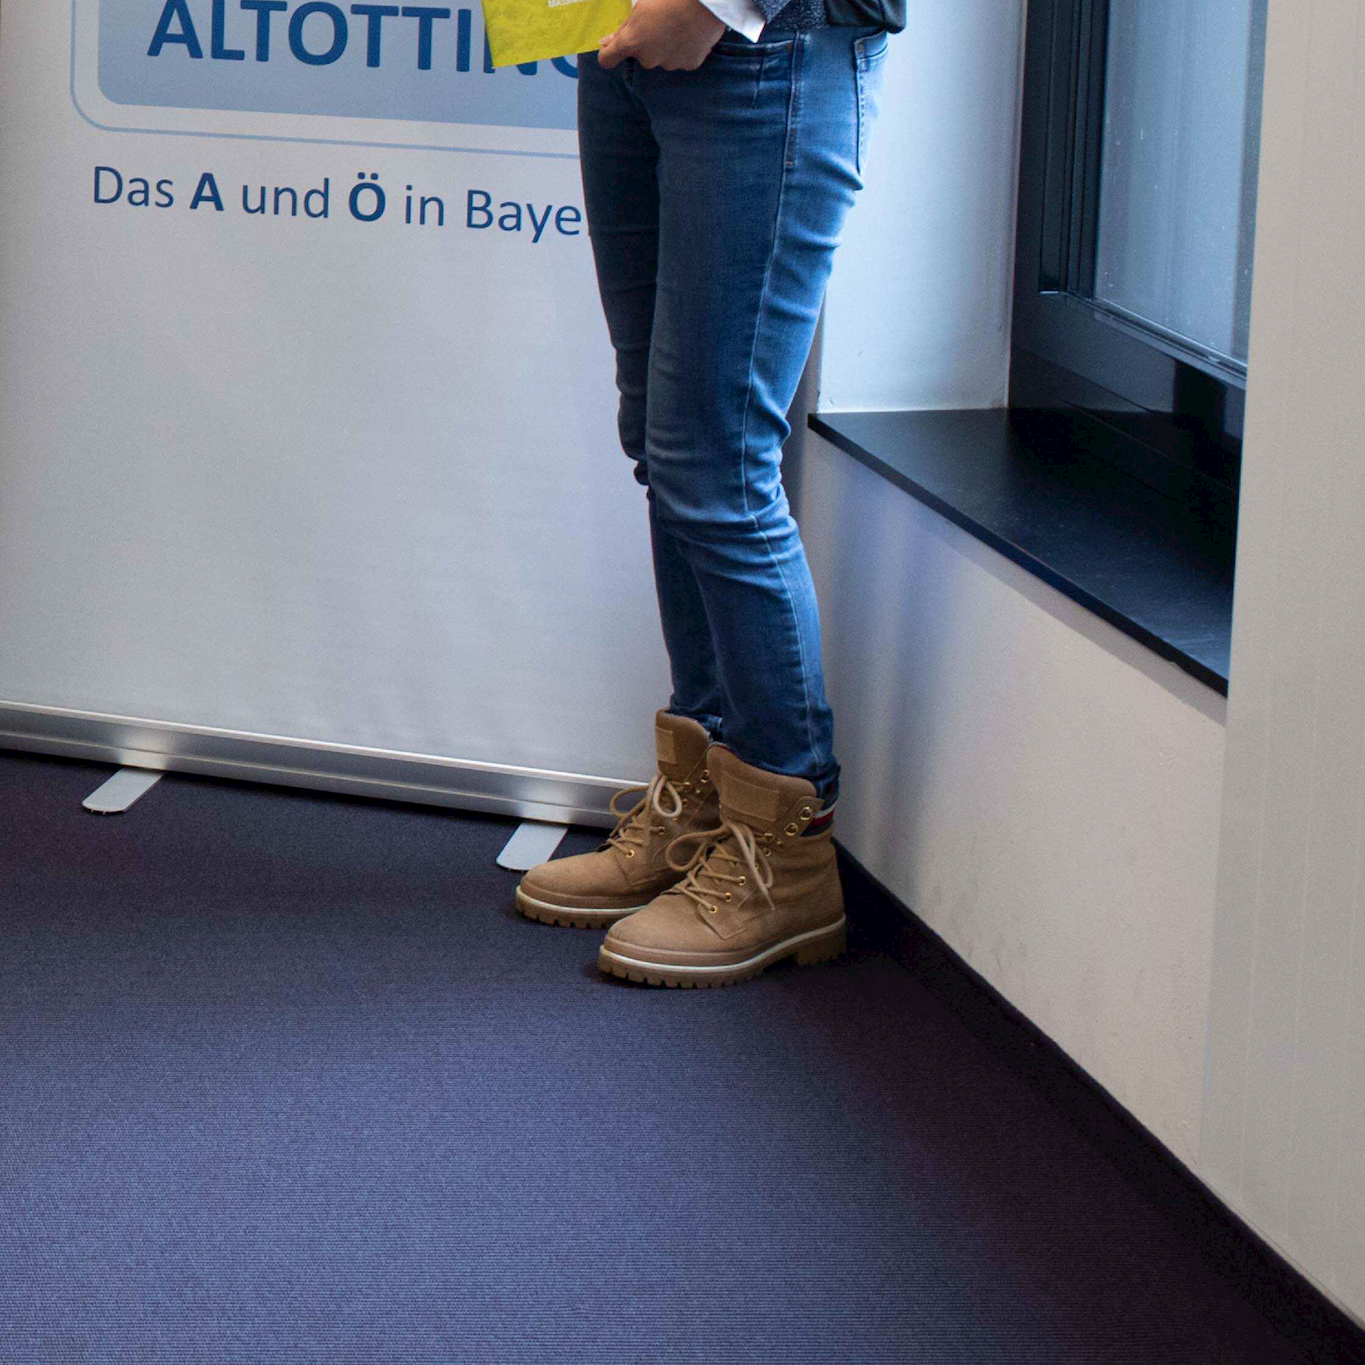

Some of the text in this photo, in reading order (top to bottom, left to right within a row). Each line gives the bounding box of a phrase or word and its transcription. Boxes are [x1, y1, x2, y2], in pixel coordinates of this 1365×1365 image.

[92, 166, 582, 244] Das A und Ö in Baye
